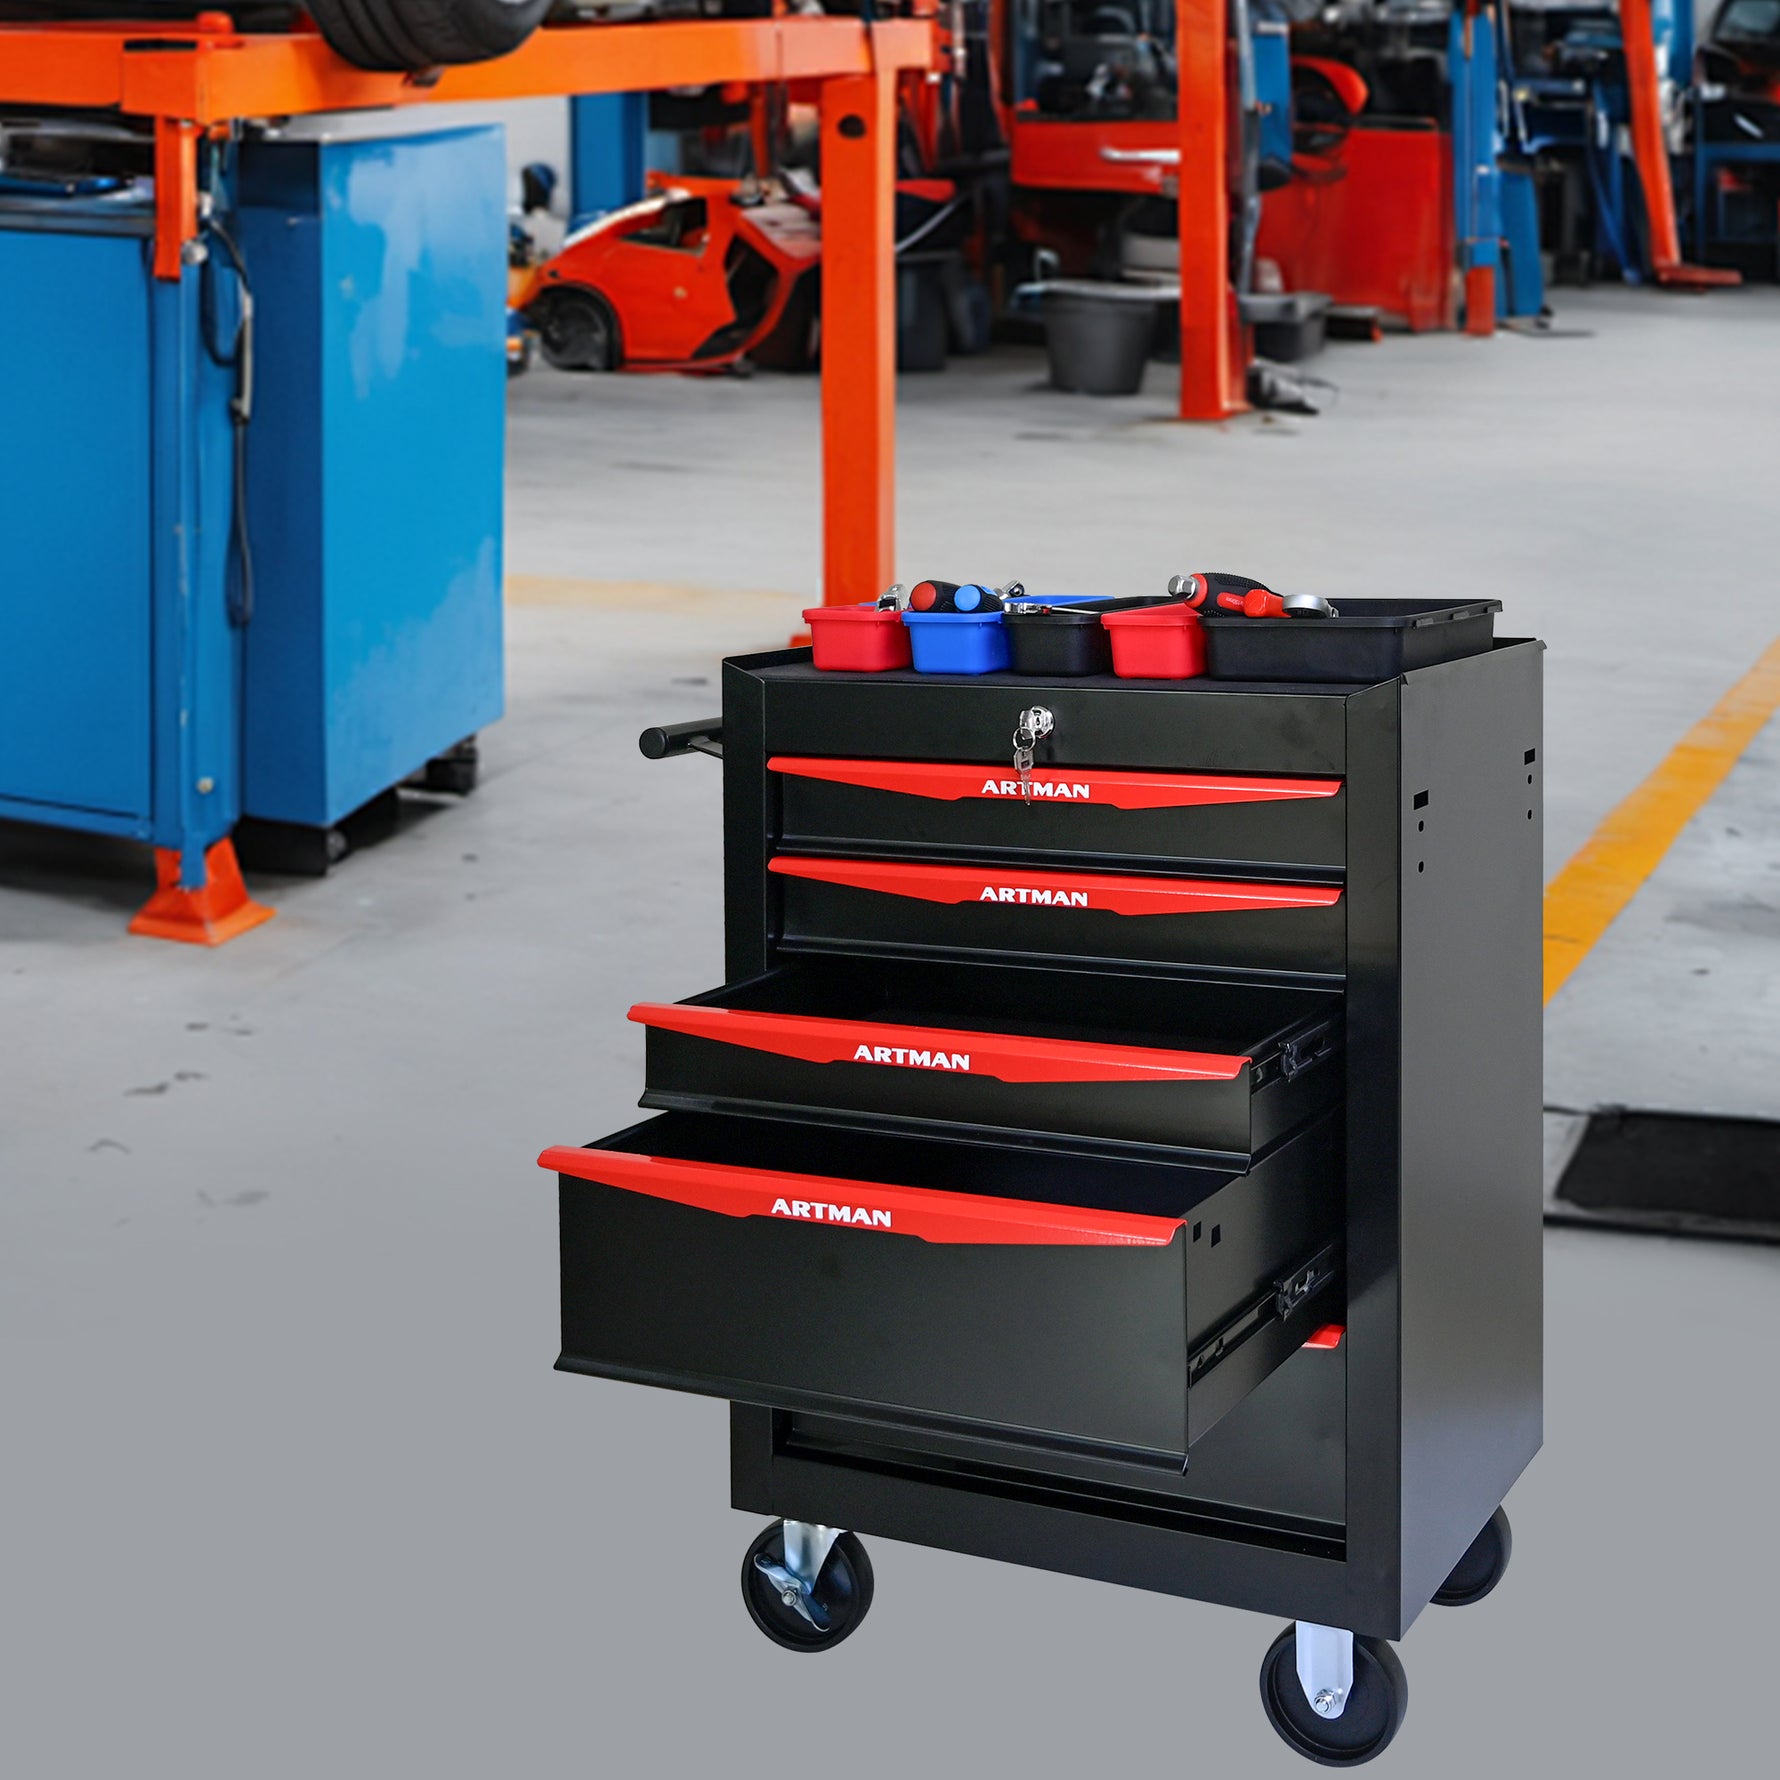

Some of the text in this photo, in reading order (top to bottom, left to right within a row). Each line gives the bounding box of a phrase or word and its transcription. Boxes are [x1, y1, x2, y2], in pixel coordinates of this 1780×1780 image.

[980, 886, 1088, 906] ARTMAN
[853, 1045, 970, 1070] ARTMAN
[771, 1198, 892, 1227] ARTMAN
